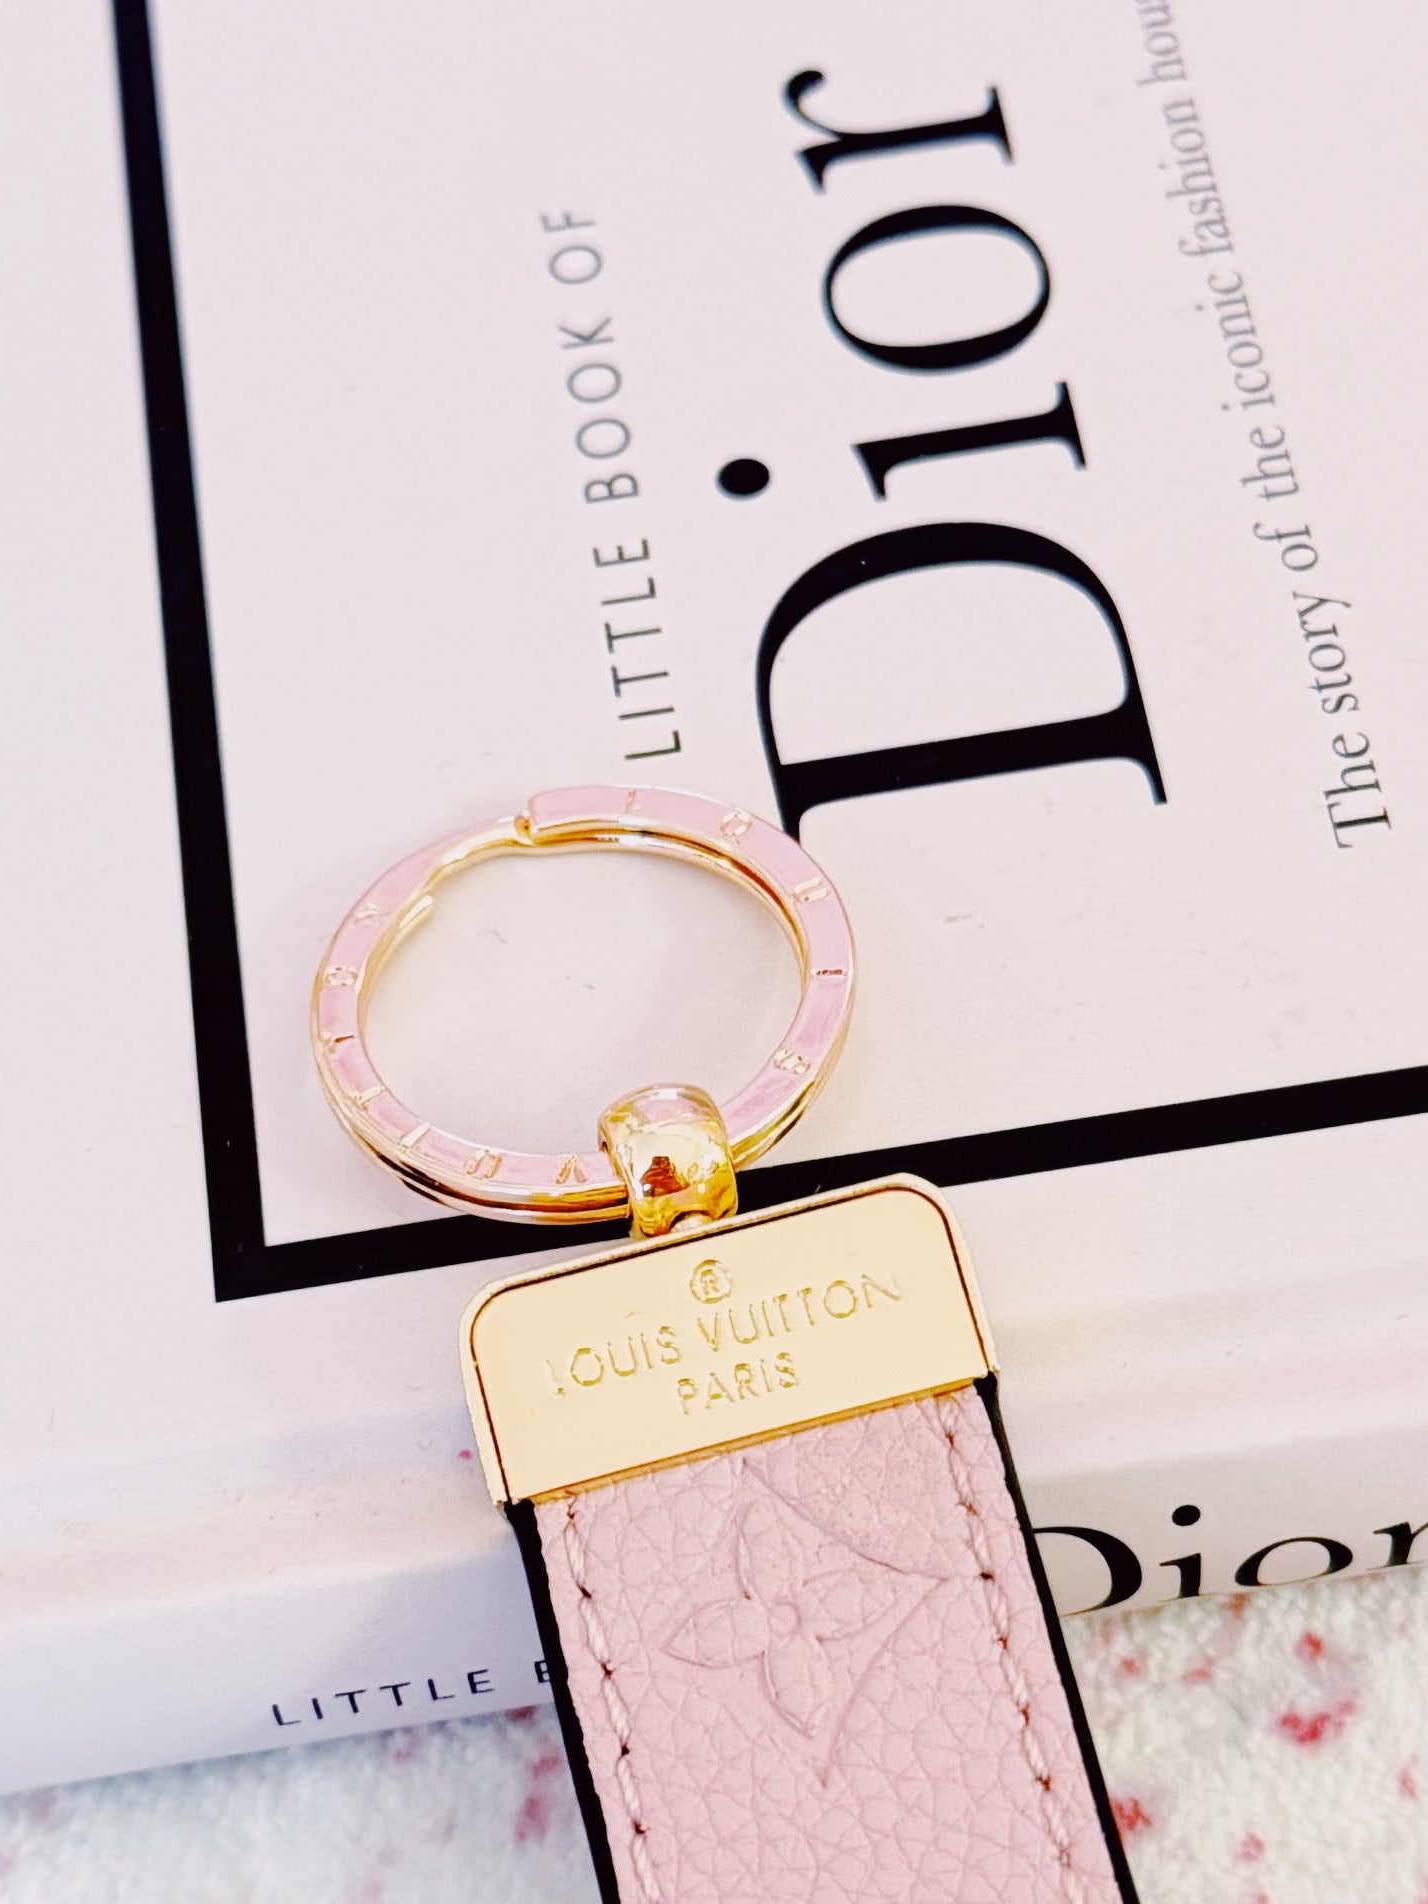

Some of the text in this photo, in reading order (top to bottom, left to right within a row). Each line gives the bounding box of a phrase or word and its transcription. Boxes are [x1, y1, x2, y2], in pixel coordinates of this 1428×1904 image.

[1157, 96, 1236, 259] fashion
[1195, 271, 1277, 414] iconic
[538, 209, 683, 762] LITTLE BOOK OF
[716, 68, 1169, 844] Dior
[1239, 424, 1301, 503] the
[1252, 521, 1320, 573] of
[1290, 589, 1360, 717] story
[1315, 732, 1393, 850] The
[543, 1269, 904, 1398] LOUIS VUITTON
[676, 1351, 800, 1417] PARIS
[272, 1668, 494, 1727] LITTLE
